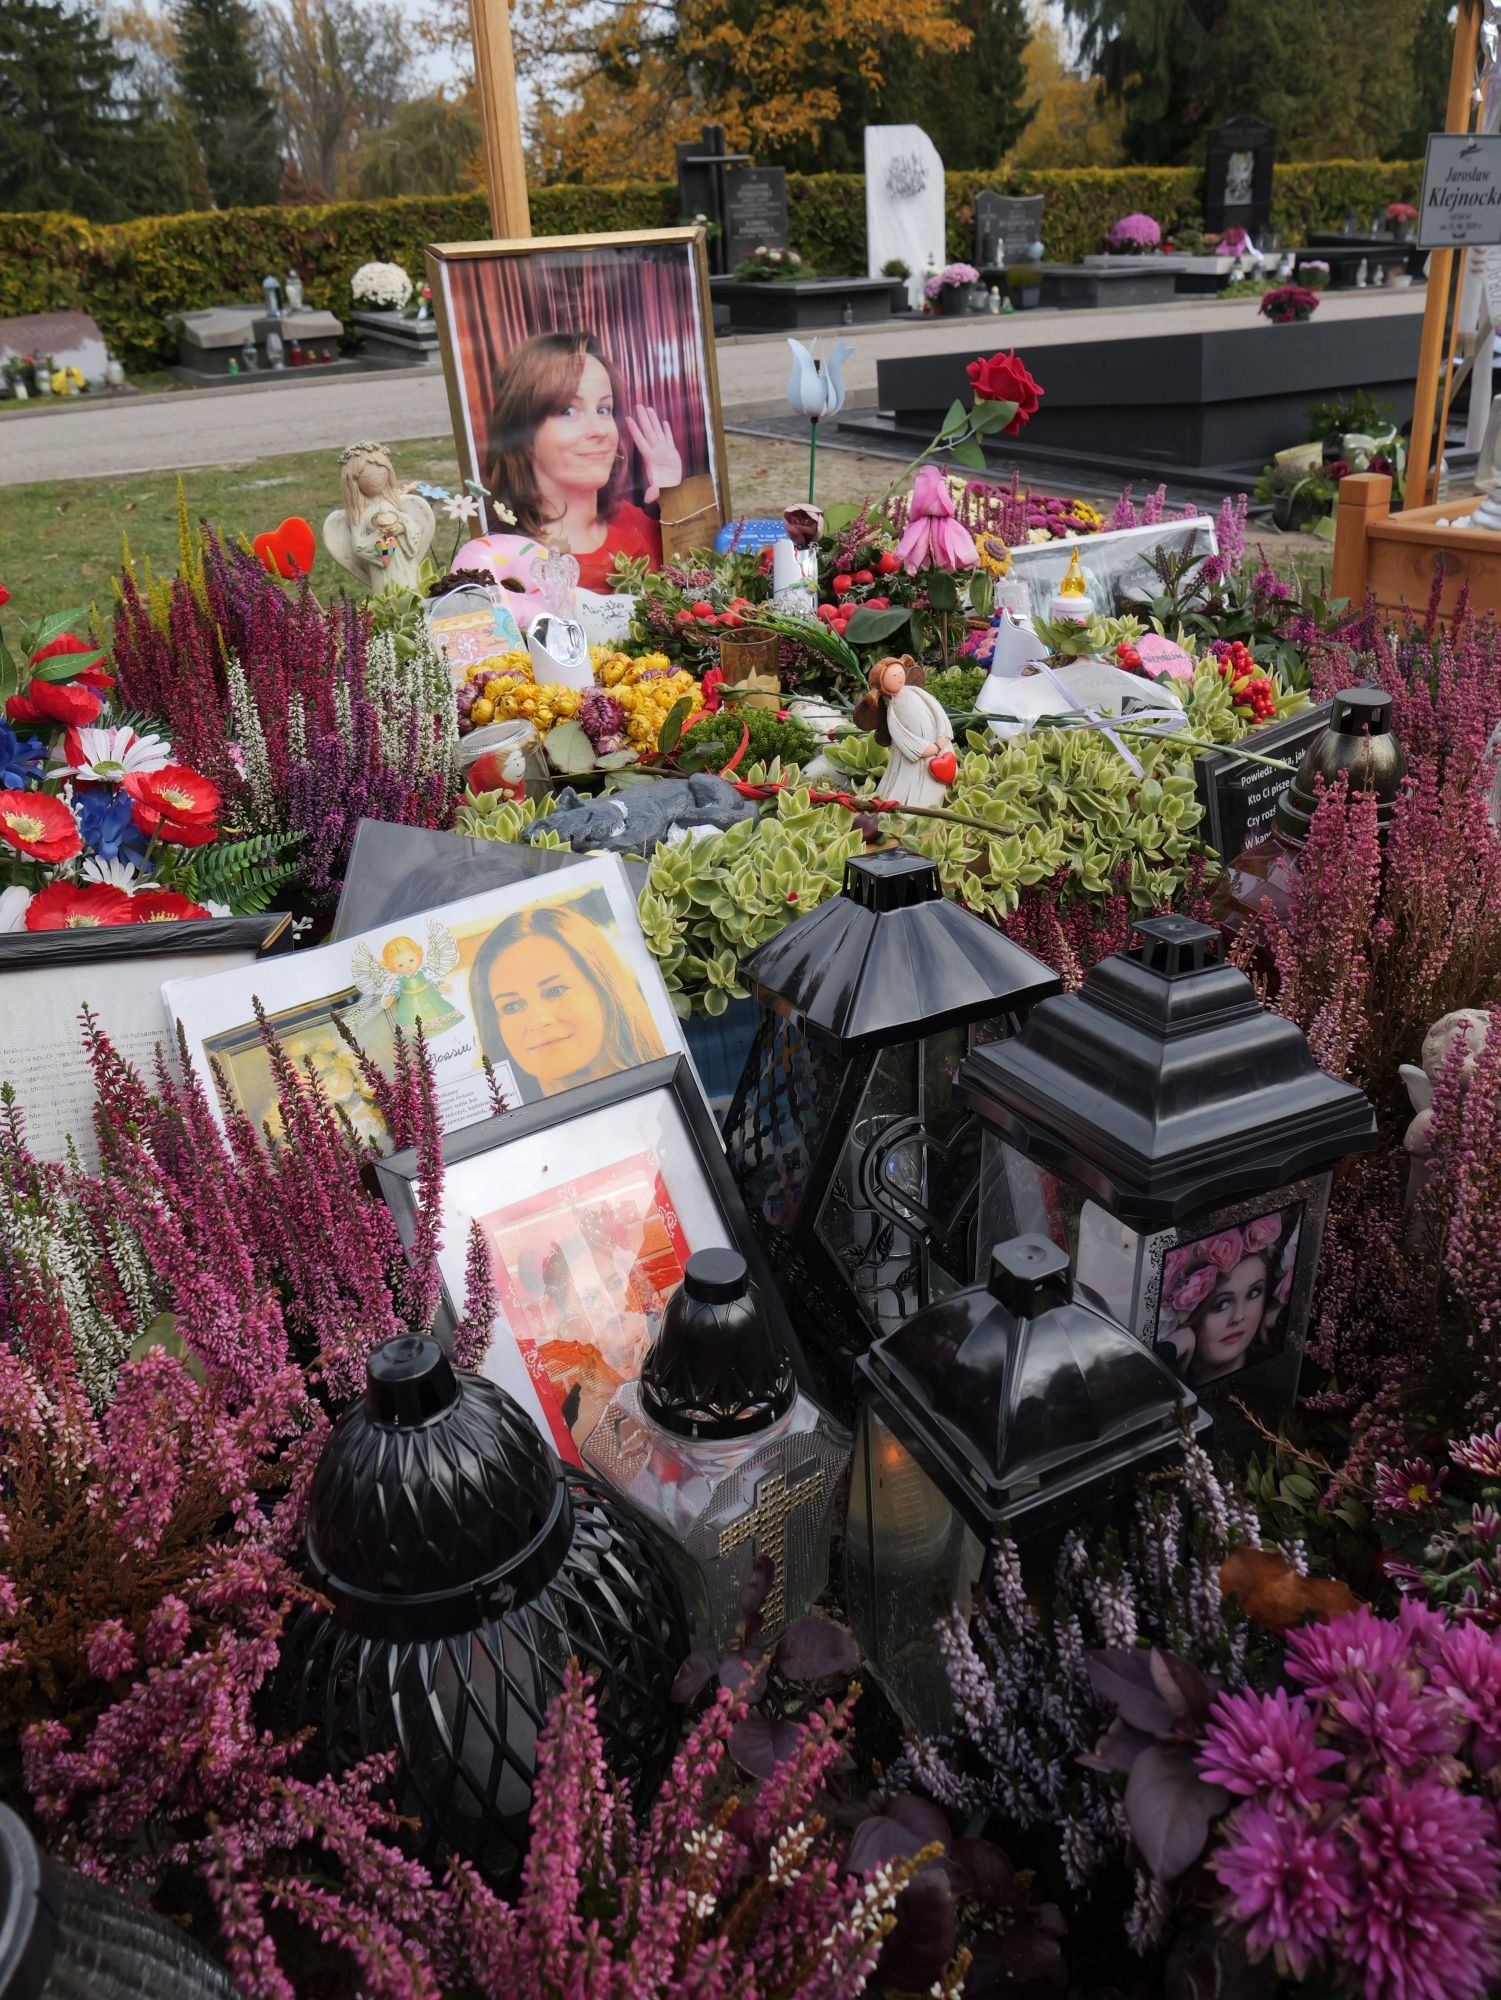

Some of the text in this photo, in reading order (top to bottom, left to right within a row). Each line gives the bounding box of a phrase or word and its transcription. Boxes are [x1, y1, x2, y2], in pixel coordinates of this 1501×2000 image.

[1240, 765, 1273, 788] Powiedz
[1247, 779, 1290, 806] Kto Ci pisze
[1246, 804, 1277, 828] Czy rozś
[1244, 831, 1272, 849] W kan
